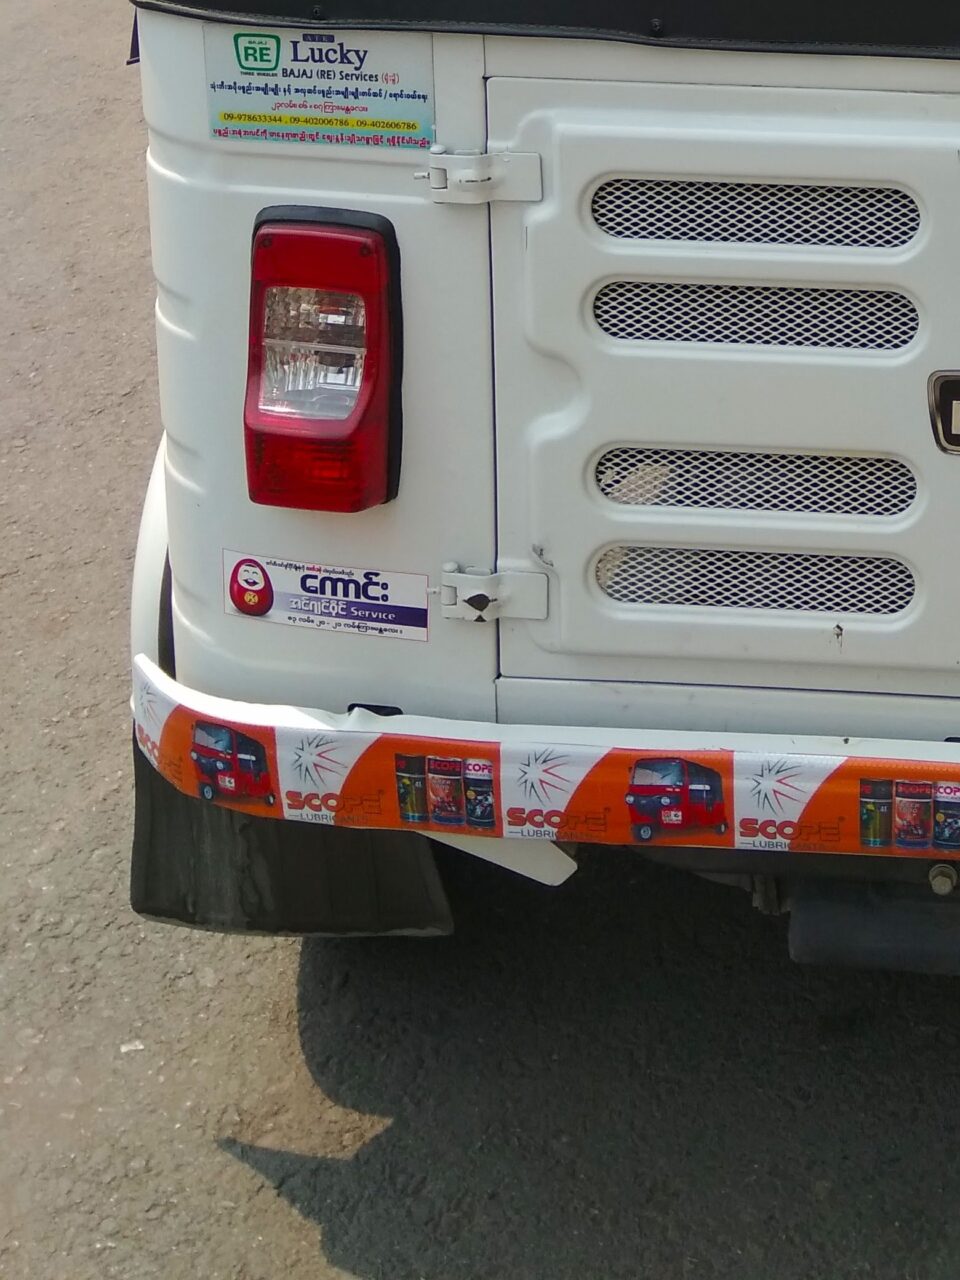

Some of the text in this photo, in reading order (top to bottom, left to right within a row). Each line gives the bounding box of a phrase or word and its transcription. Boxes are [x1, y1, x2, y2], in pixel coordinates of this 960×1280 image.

[243, 46, 272, 63] RE
[290, 40, 368, 71] Lucky
[282, 67, 313, 79] BAJAJ
[316, 68, 336, 81] (RE)
[339, 70, 379, 83] Services
[356, 119, 417, 131] 09-402606786
[300, 571, 389, 602] ကောင်း
[350, 606, 396, 620] Service
